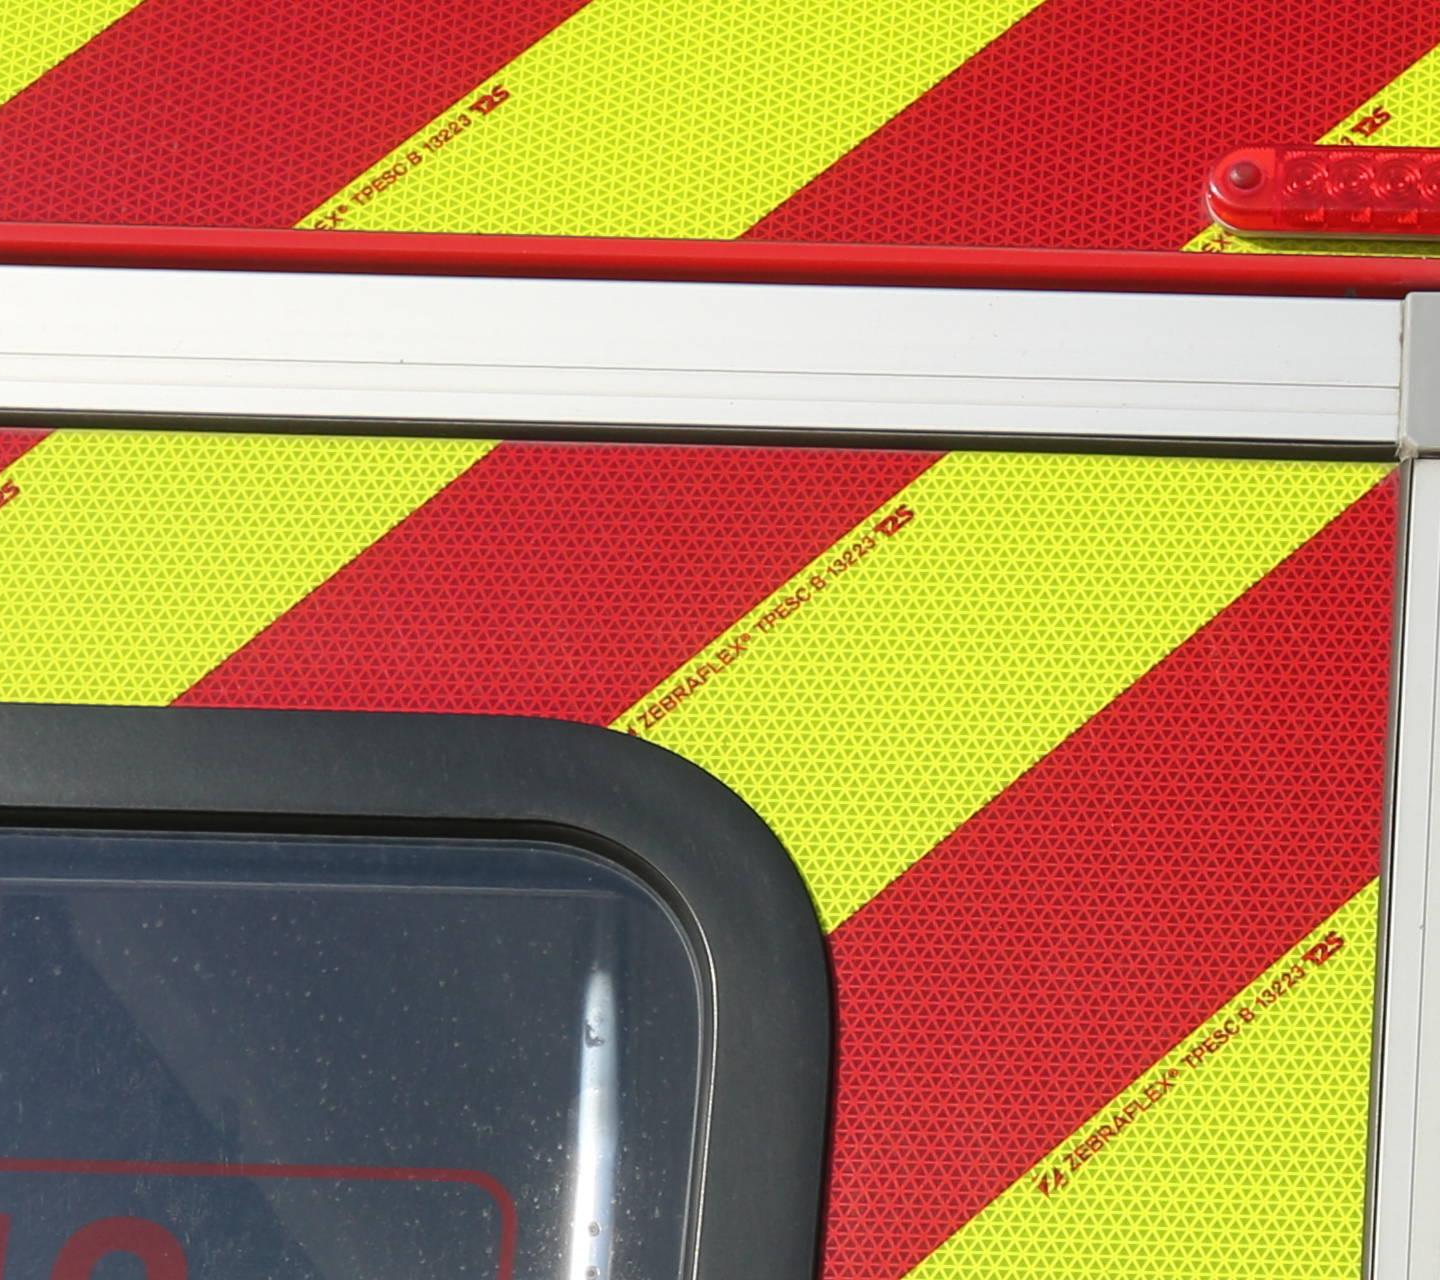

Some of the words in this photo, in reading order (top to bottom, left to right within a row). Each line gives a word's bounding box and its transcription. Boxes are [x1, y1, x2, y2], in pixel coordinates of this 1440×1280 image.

[350, 161, 407, 206] TPESC
[405, 149, 423, 167] B
[421, 112, 473, 154] 13223
[754, 586, 813, 634] TPESC
[809, 573, 828, 592] B
[824, 533, 878, 578] 13223
[1181, 1019, 1239, 1070] TPESC
[1238, 1005, 1256, 1023] B
[1253, 962, 1307, 1010] 13223
